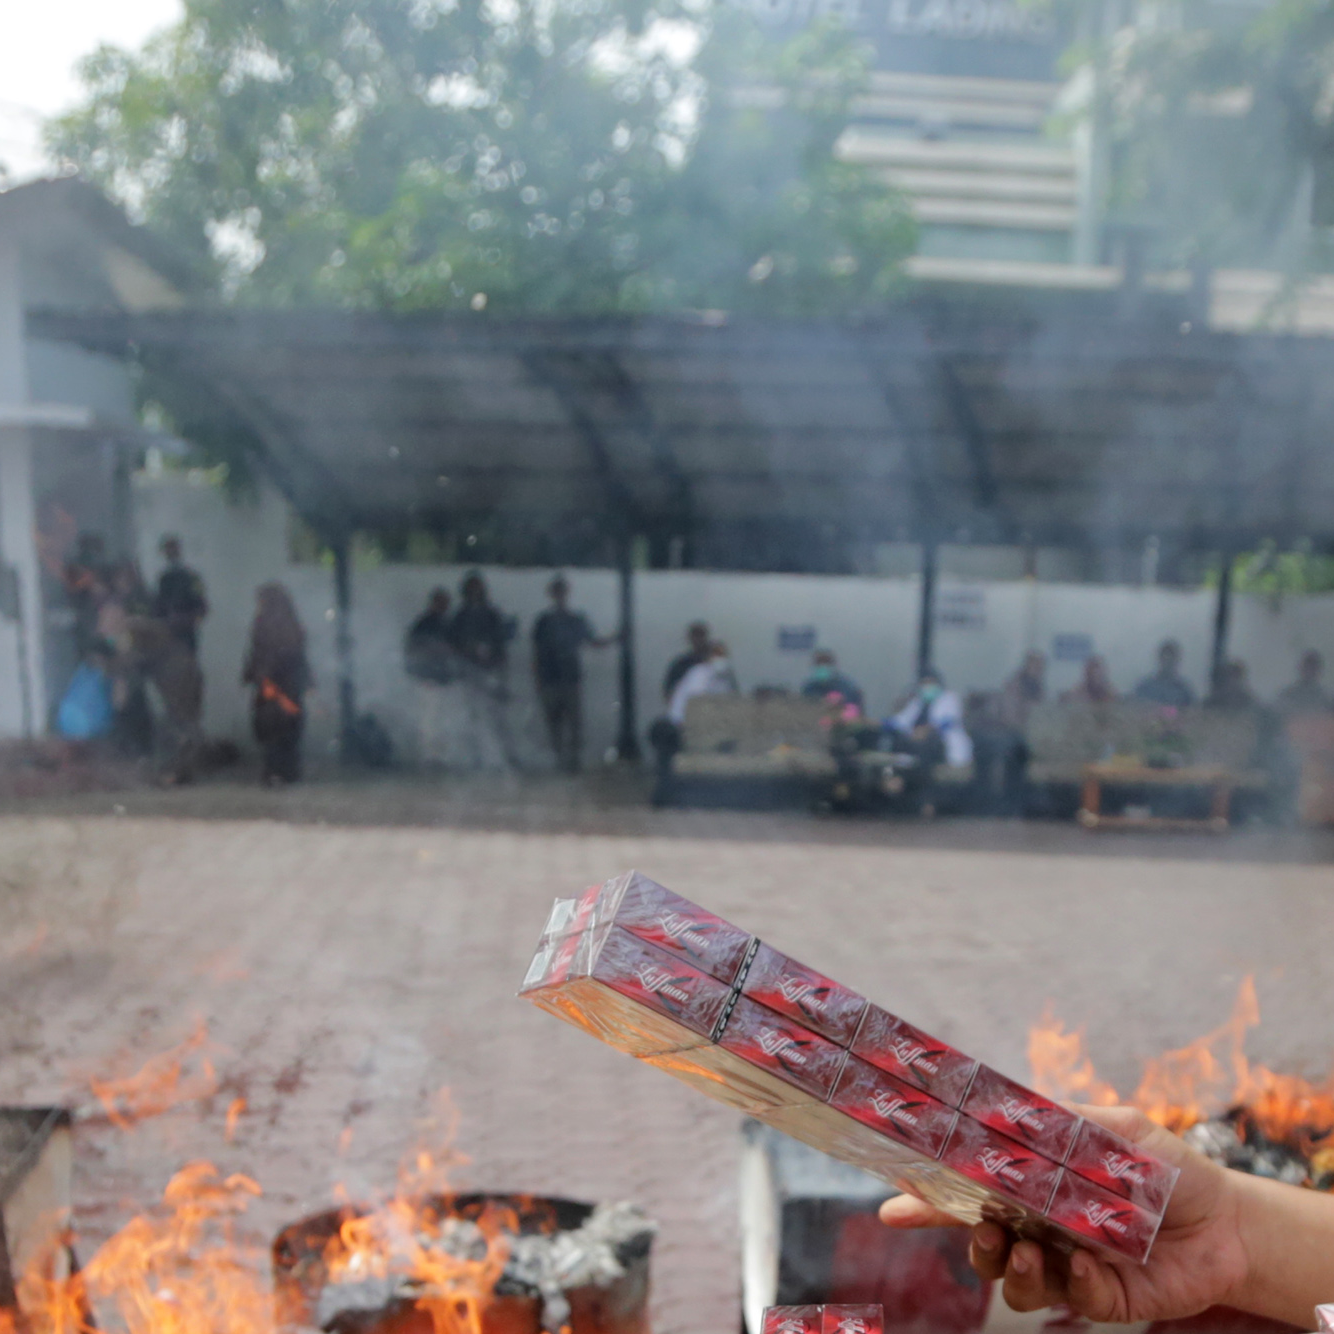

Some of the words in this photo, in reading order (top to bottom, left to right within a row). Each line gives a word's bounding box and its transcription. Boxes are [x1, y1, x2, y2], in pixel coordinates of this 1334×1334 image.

[657, 909, 710, 949] Luffman
[633, 963, 689, 1002] Luffman
[774, 974, 829, 1012] Luffman
[755, 1027, 807, 1065] Luffman
[888, 1037, 938, 1074] Luffman
[868, 1089, 918, 1126] Luffman
[998, 1096, 1045, 1132] Luffman
[976, 1147, 1025, 1182] Luffman
[1101, 1151, 1145, 1185] Luffman
[1082, 1200, 1127, 1233] Luffman
